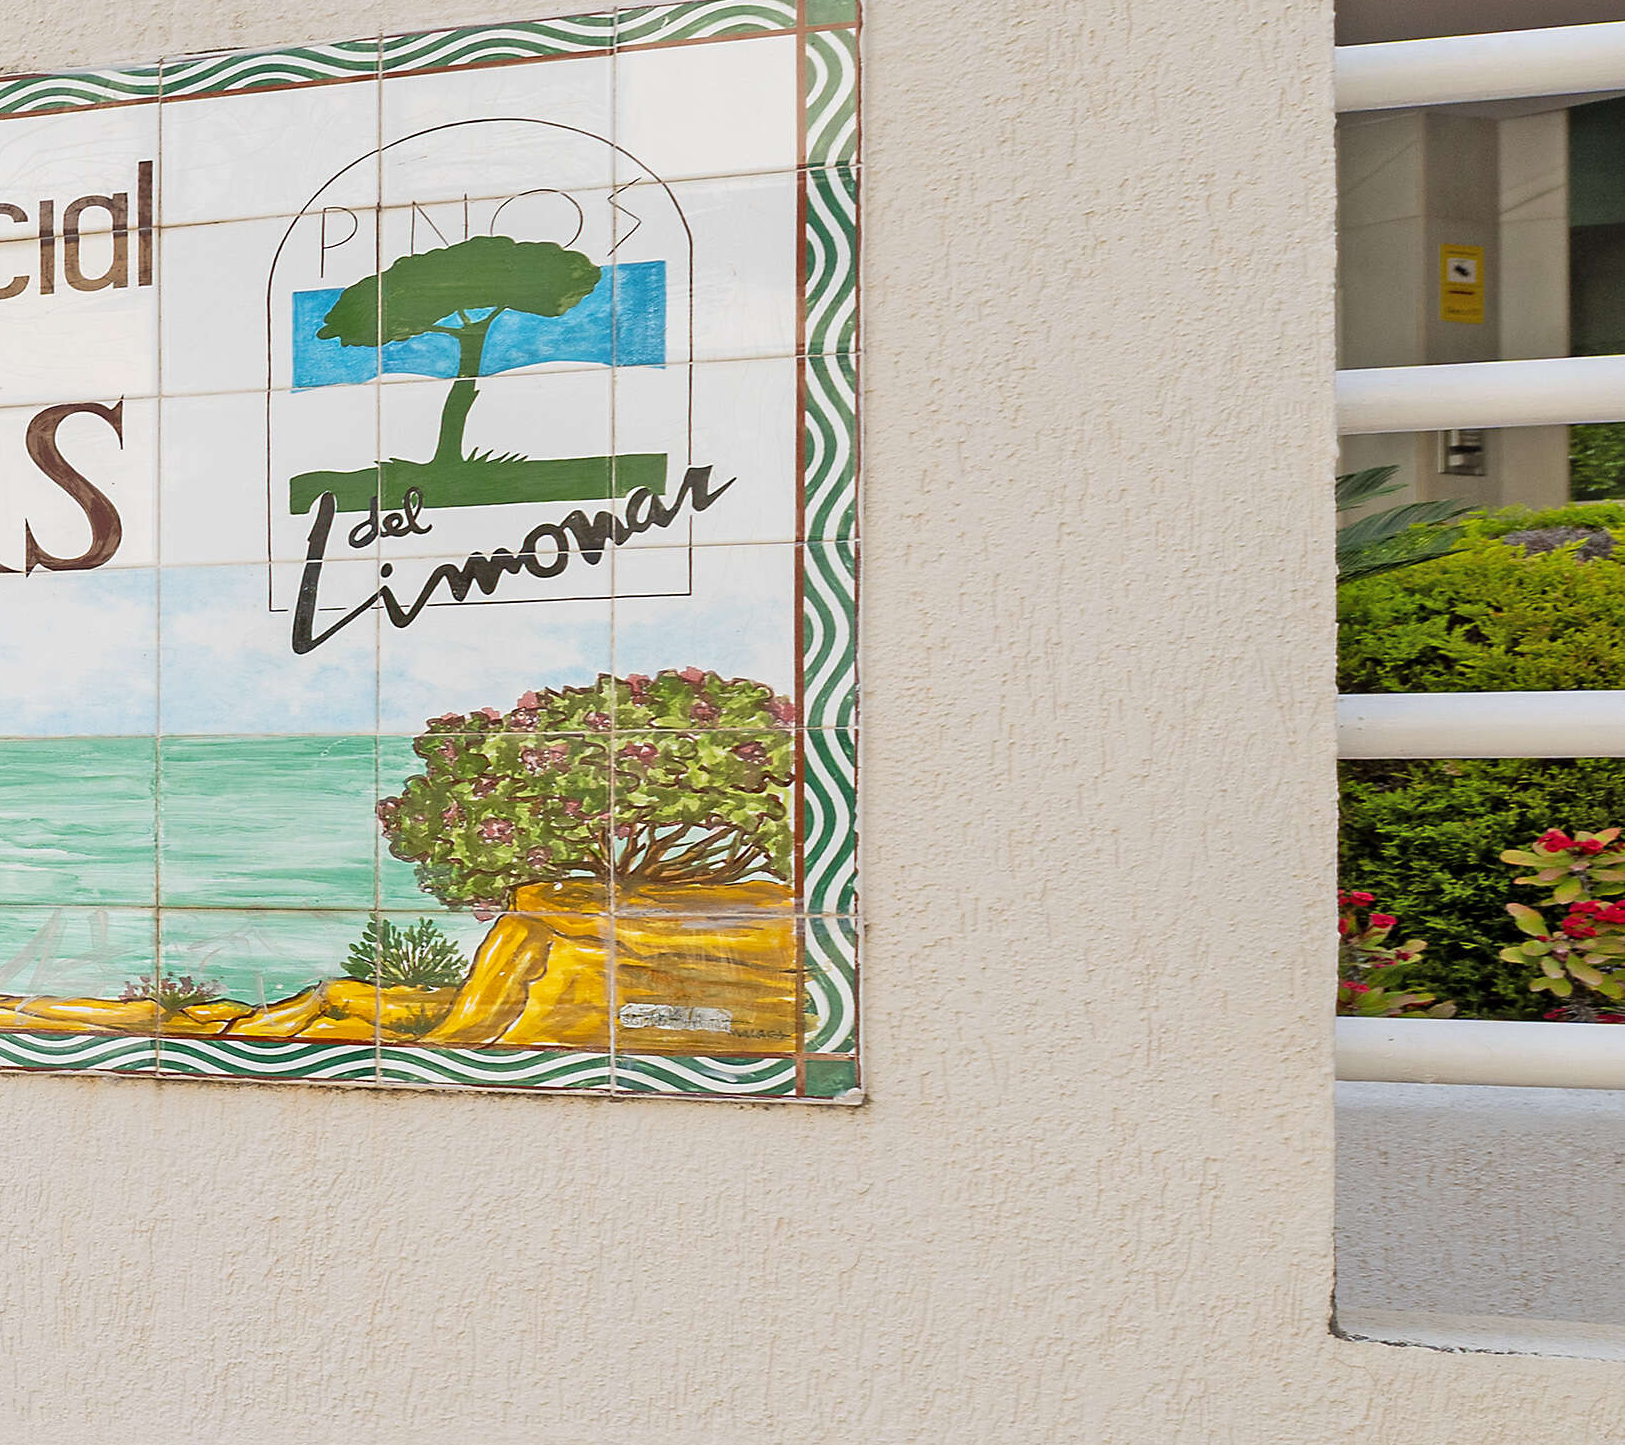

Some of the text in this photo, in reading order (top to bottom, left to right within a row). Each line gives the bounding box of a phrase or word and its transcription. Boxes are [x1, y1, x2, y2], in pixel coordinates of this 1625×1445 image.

[320, 176, 642, 278] PINOS
[292, 465, 736, 654] Limonar
[348, 487, 431, 548] del
